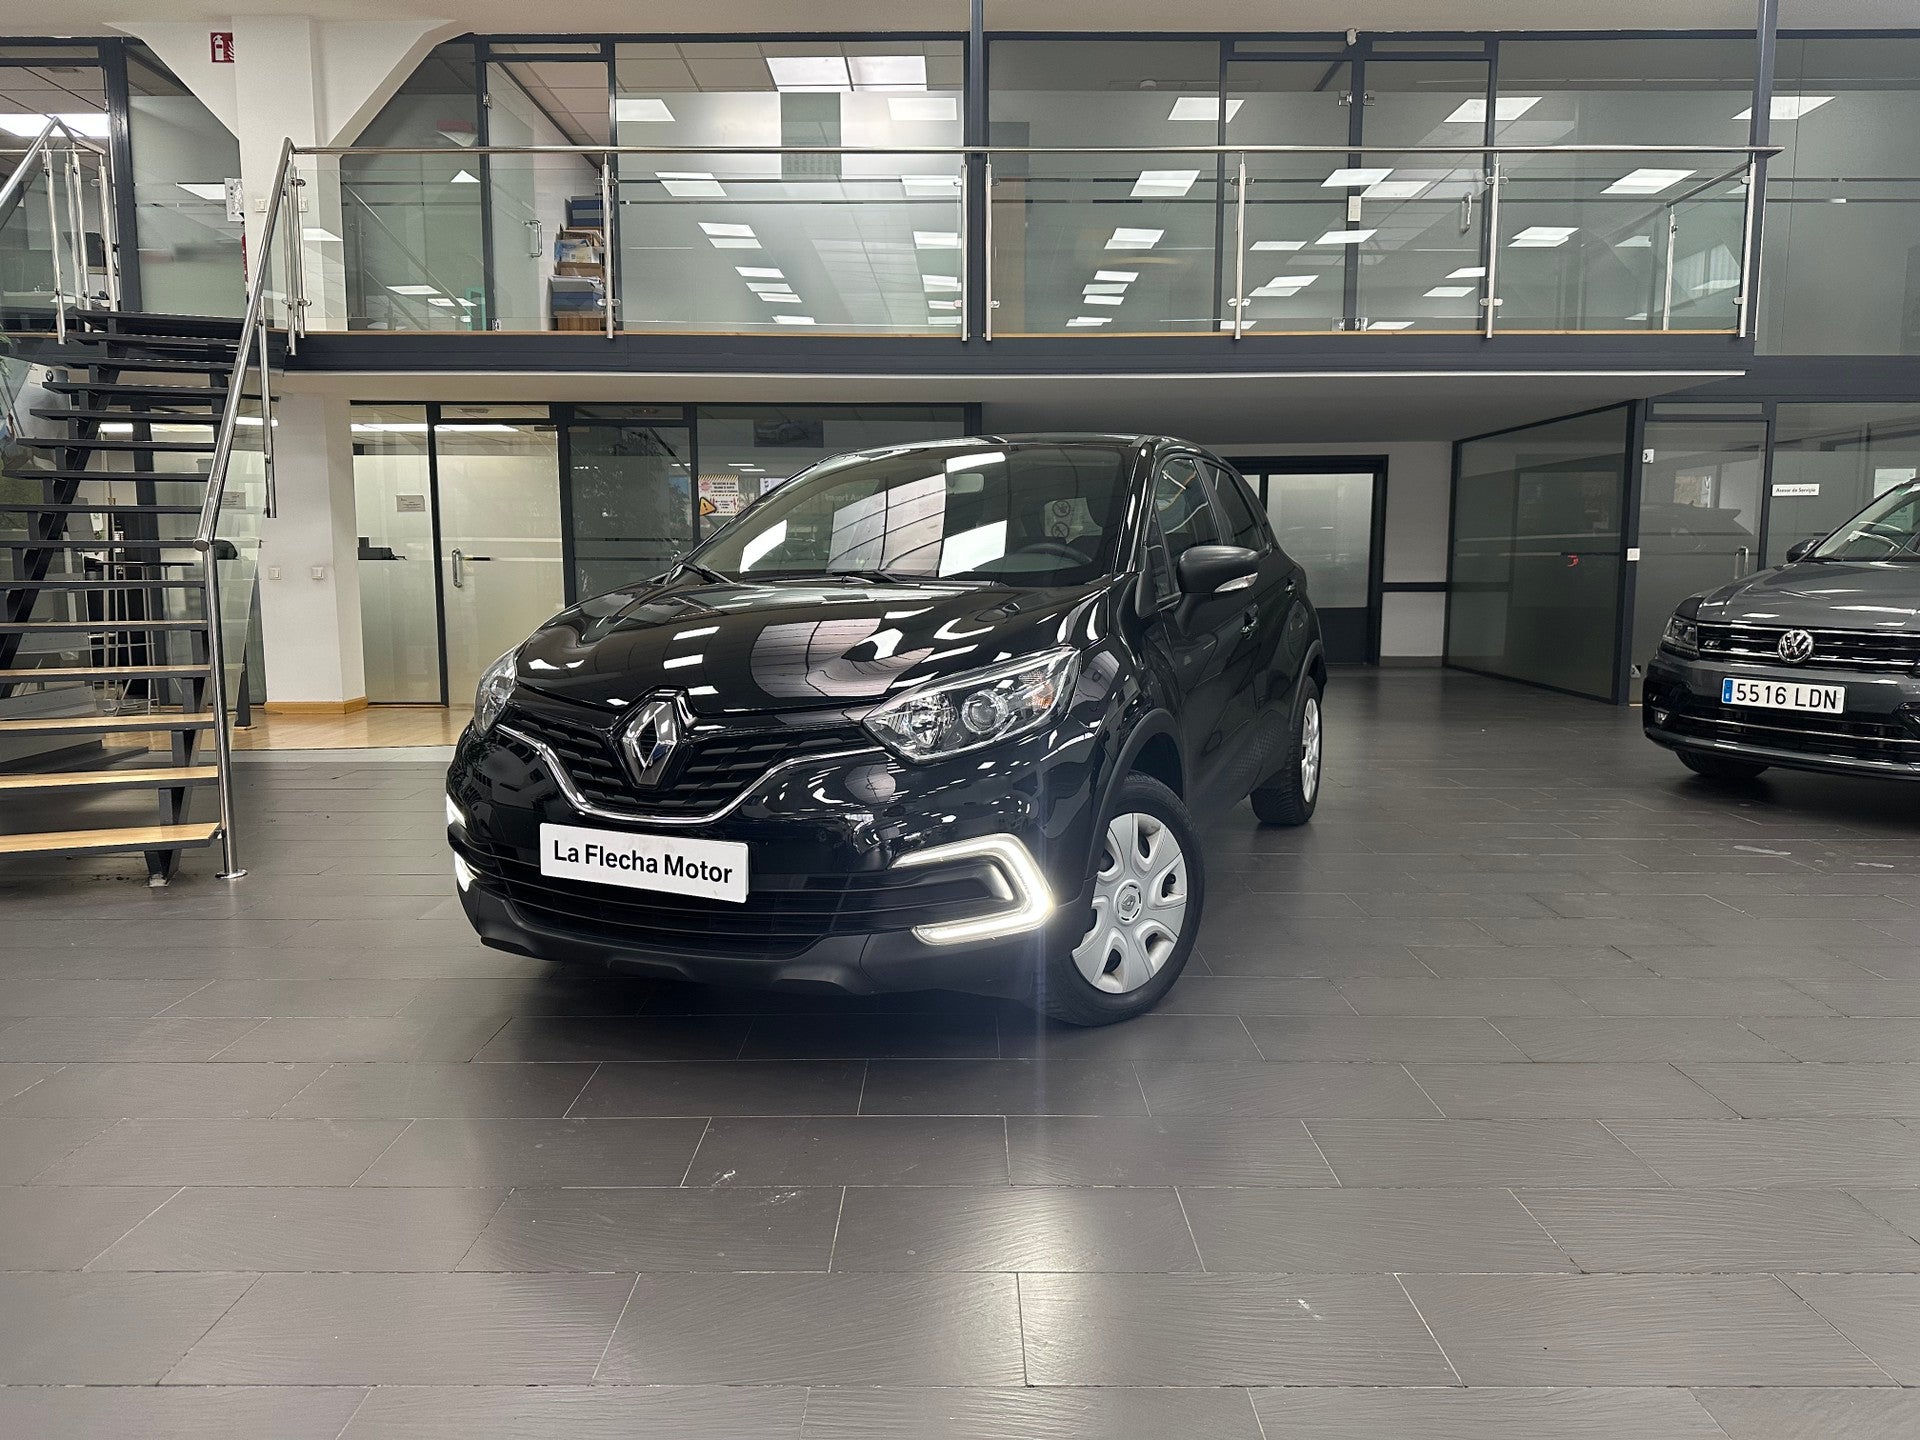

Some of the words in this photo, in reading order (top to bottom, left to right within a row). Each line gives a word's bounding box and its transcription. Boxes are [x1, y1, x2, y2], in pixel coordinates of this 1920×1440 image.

[1736, 683, 1787, 705] 5516
[1794, 687, 1837, 710] LDN
[554, 839, 579, 863] La
[585, 843, 658, 874] Flecha
[664, 853, 733, 884] Motor
